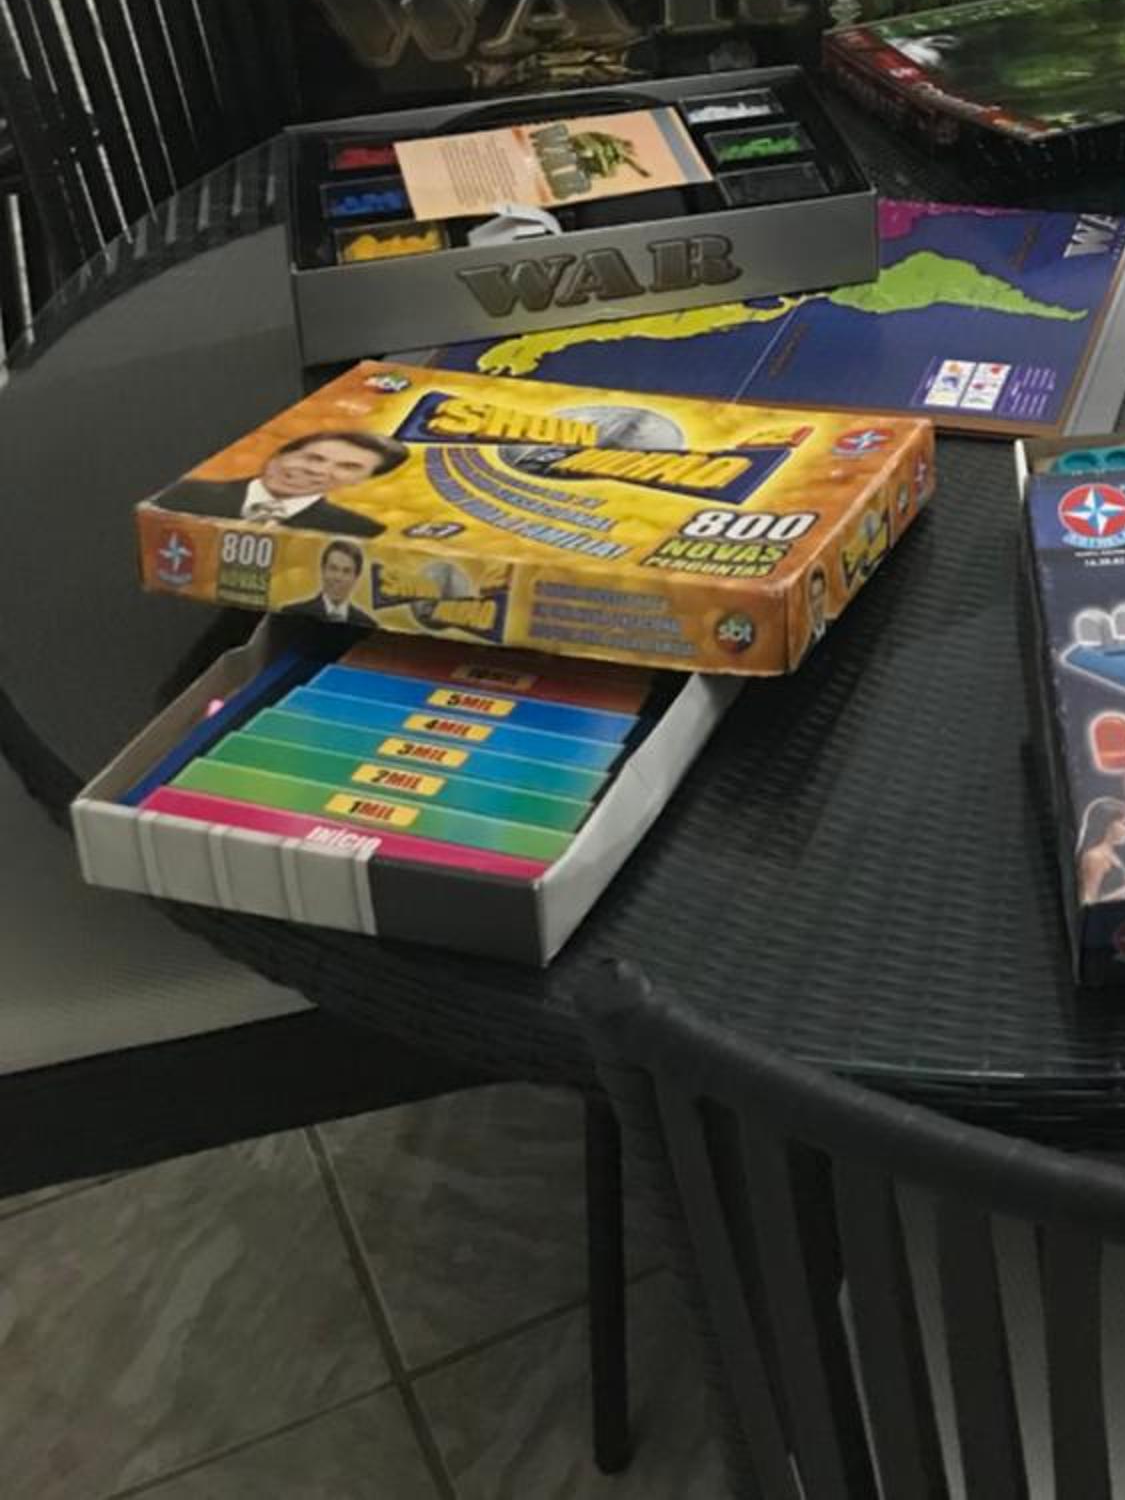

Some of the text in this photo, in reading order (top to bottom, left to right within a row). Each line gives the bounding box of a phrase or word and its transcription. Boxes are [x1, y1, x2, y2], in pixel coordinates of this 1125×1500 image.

[457, 233, 743, 319] WAR
[426, 398, 598, 447] SHOW
[682, 511, 818, 541] 800
[222, 532, 273, 568] 800
[660, 540, 784, 563] NOVAS
